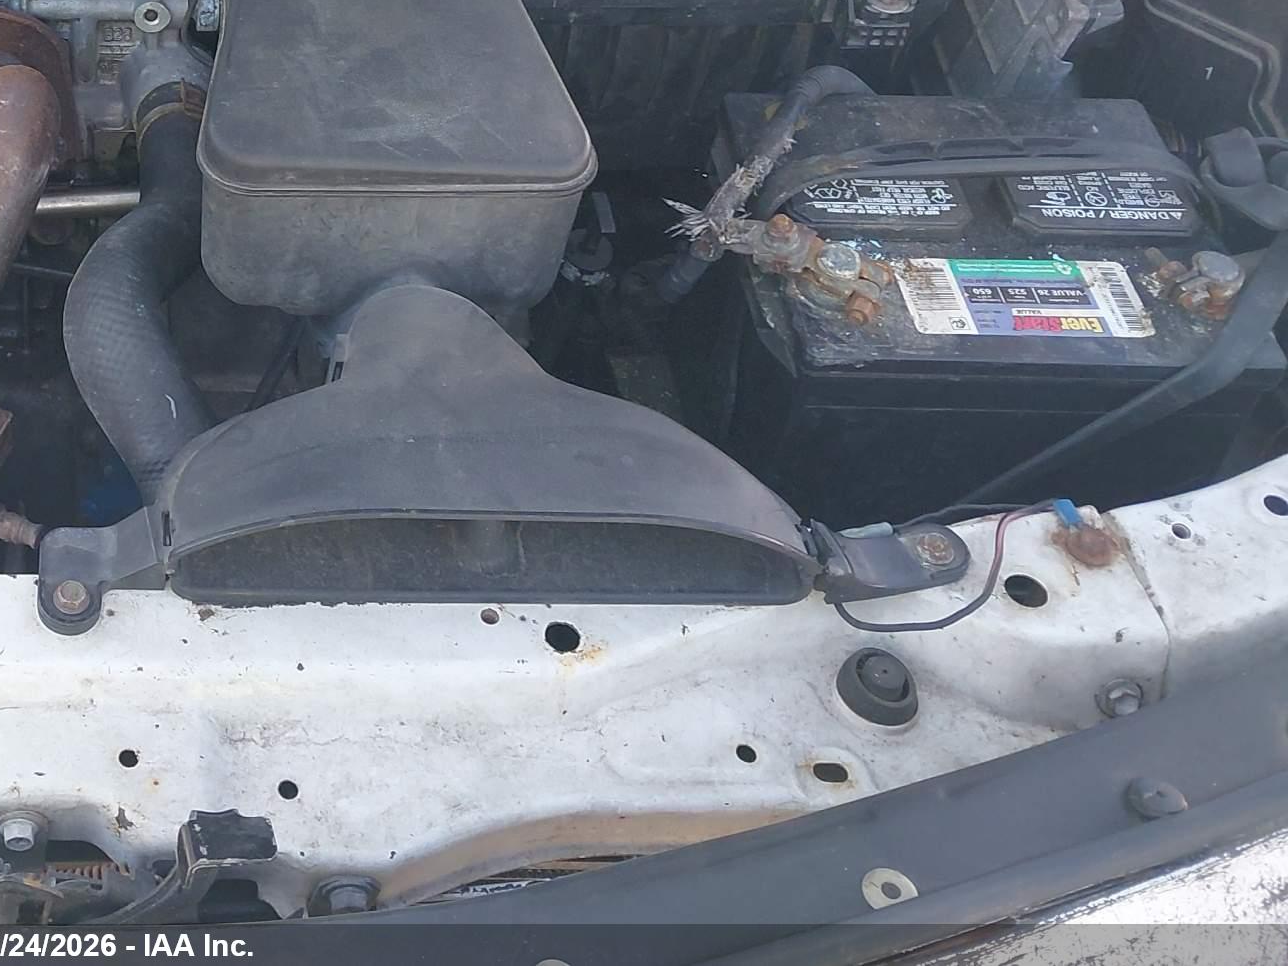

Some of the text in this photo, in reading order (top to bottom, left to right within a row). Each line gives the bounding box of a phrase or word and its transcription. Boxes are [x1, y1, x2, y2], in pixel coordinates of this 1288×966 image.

[1042, 208, 1095, 218] POISON
[1110, 210, 1170, 220] DANGER
[1050, 289, 1082, 297] VALUE
[1014, 316, 1103, 333] EverStart
